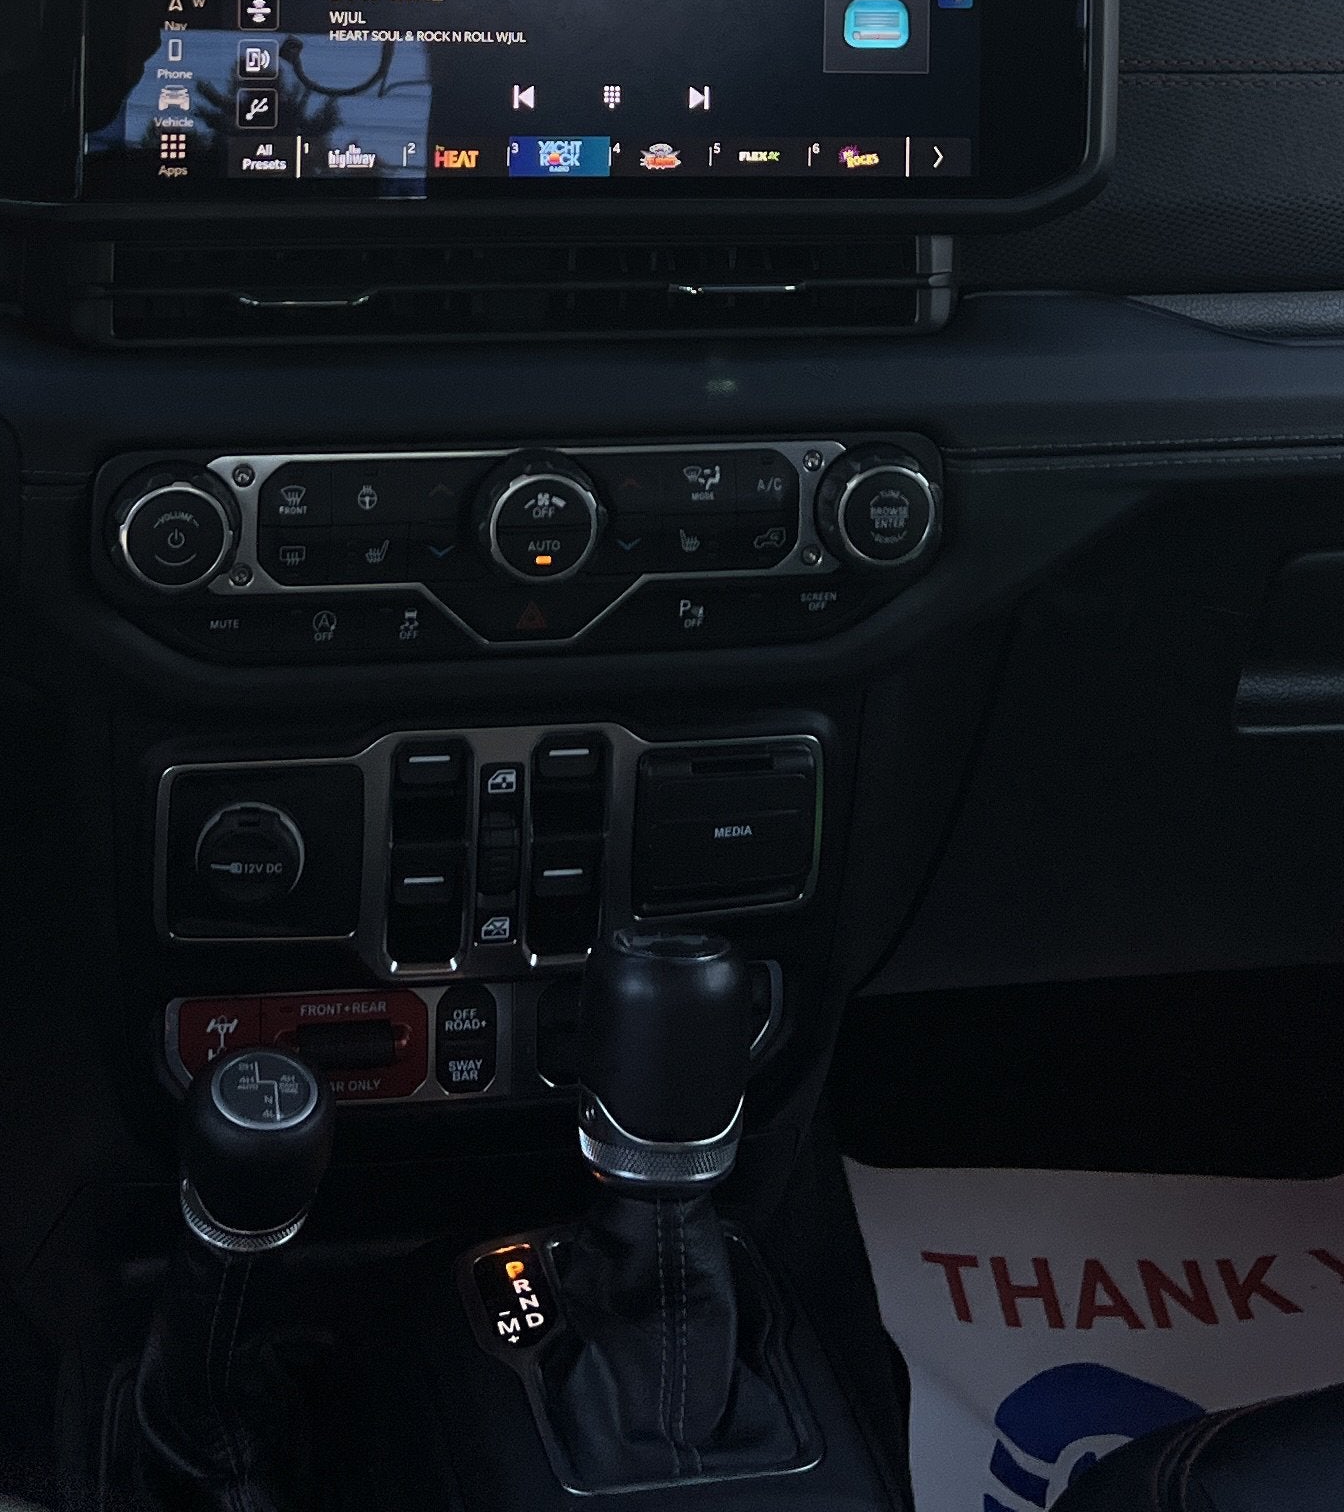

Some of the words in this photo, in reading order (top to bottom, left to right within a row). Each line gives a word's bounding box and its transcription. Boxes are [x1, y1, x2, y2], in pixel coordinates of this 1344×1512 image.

[329, 11, 366, 25] WJUL
[165, 21, 187, 30] Nav
[329, 30, 369, 42] HEART
[371, 30, 403, 42] SOUL
[405, 31, 414, 42] &
[417, 31, 451, 42] ROCK
[452, 31, 462, 42] N
[464, 31, 494, 43] ROLL
[496, 32, 527, 45] WJUL
[158, 69, 192, 79] Phone
[155, 117, 194, 128] Vehicle
[256, 144, 273, 156] All
[407, 143, 416, 154] 2
[511, 143, 519, 154] 3
[537, 141, 583, 154] YACHT
[612, 143, 621, 154] 4
[713, 143, 721, 154] 5
[812, 143, 820, 154] 6
[242, 158, 286, 171] Presets
[328, 149, 375, 168] highway
[434, 150, 479, 168] HEAT
[540, 152, 581, 167] ROCK
[158, 165, 188, 178] Apps
[757, 477, 783, 491] A/C
[691, 491, 714, 501] MODE
[278, 505, 308, 515] FRONT
[532, 507, 556, 519] OFF
[159, 511, 194, 524] VOLUME
[528, 540, 561, 552] AUTO
[800, 591, 837, 602] SCREEN
[209, 619, 241, 631] MUTE
[684, 618, 703, 629] OFF
[314, 632, 335, 641] OFF
[398, 630, 417, 640] OFF
[714, 824, 753, 838] MEDIA
[243, 863, 263, 874] 12V
[266, 862, 284, 874] DC
[453, 1007, 477, 1021] OFF
[448, 1059, 483, 1073] SWAY
[452, 1070, 478, 1082] BAR
[348, 1078, 382, 1092] ONLY
[264, 1094, 274, 1104] N
[505, 1261, 525, 1280] P
[513, 1278, 532, 1294] R
[921, 1250, 1303, 1331] THANK
[519, 1294, 539, 1311] N
[497, 1317, 521, 1335] M
[525, 1312, 544, 1328] D
